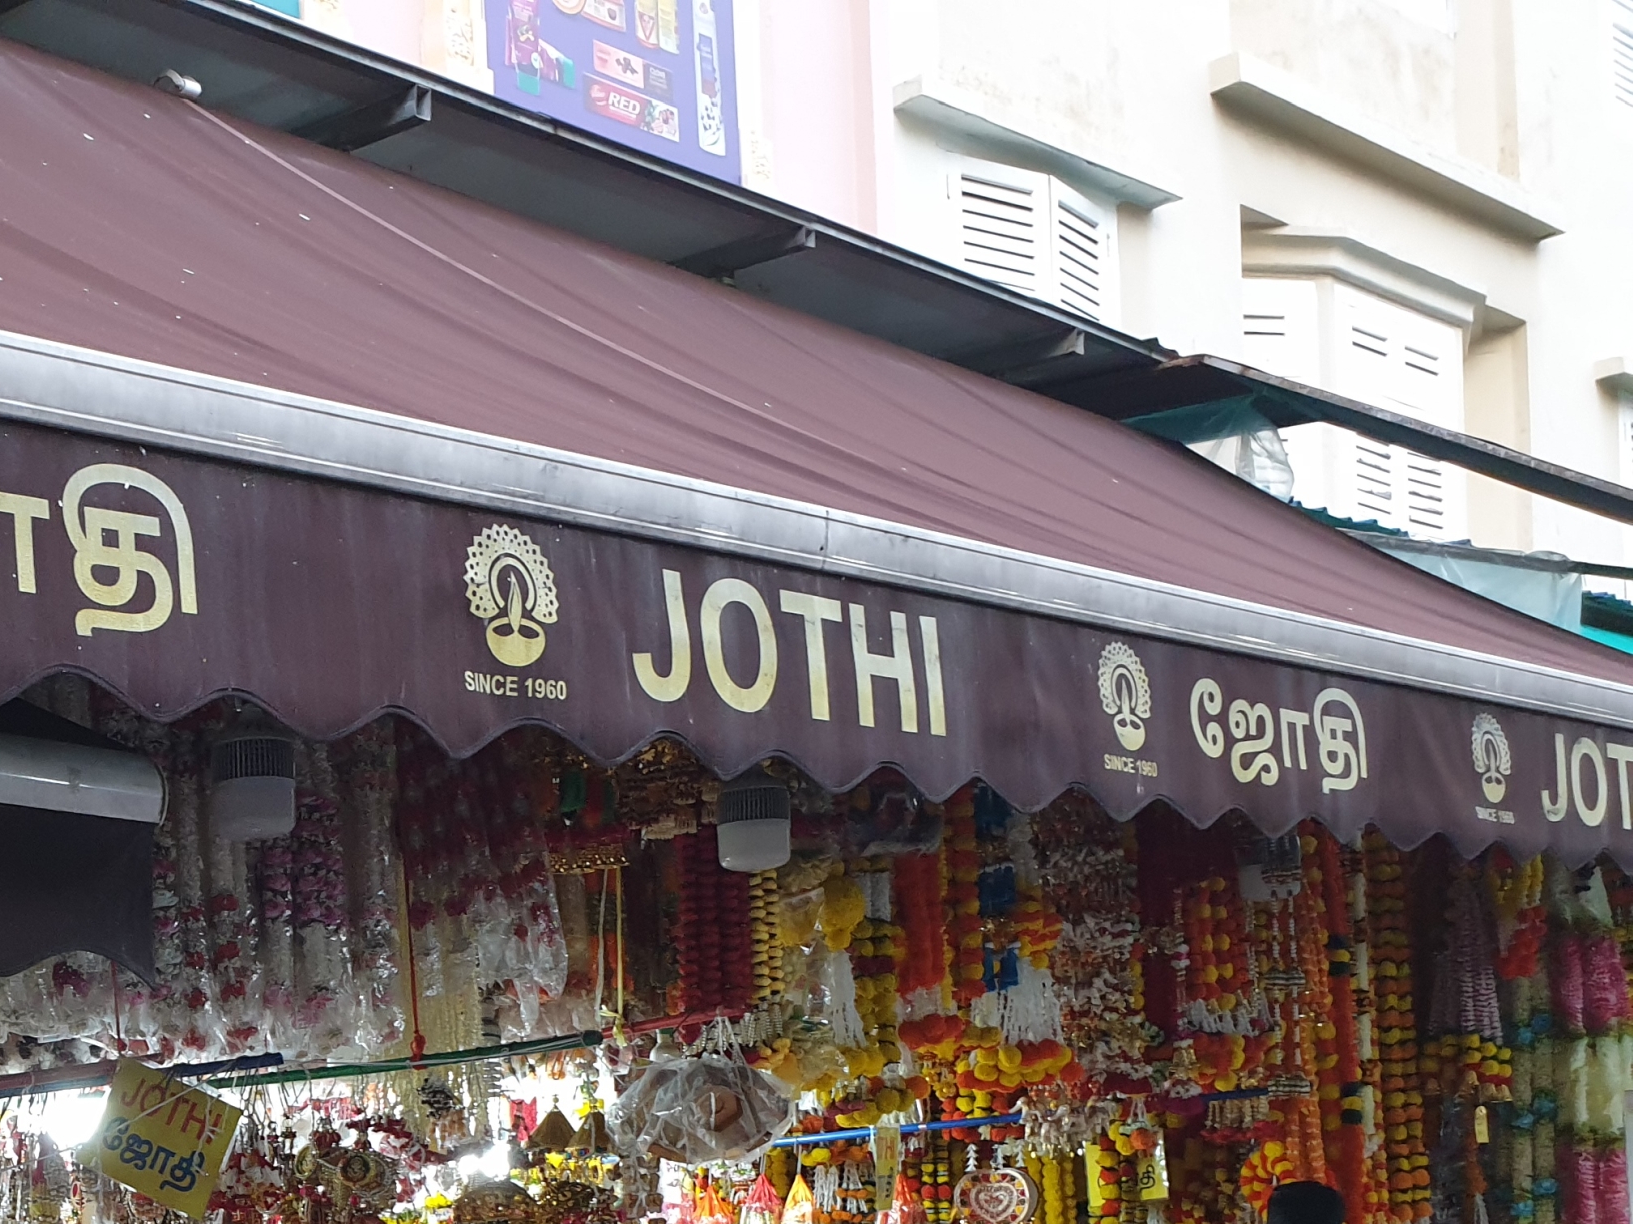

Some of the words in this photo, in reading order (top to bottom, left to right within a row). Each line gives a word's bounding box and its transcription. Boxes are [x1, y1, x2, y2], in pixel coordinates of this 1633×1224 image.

[608, 91, 640, 115] RED
[464, 670, 518, 697] SINCE
[524, 677, 567, 700] 1960
[632, 568, 947, 736] JOTHI
[1104, 754, 1135, 774] SINCE
[1135, 760, 1158, 778] 1960
[1190, 678, 1367, 794] ஜோதி
[1541, 733, 1633, 830] JOT
[120, 1078, 223, 1145] JOTHI
[102, 1116, 206, 1193] ஜோதி
